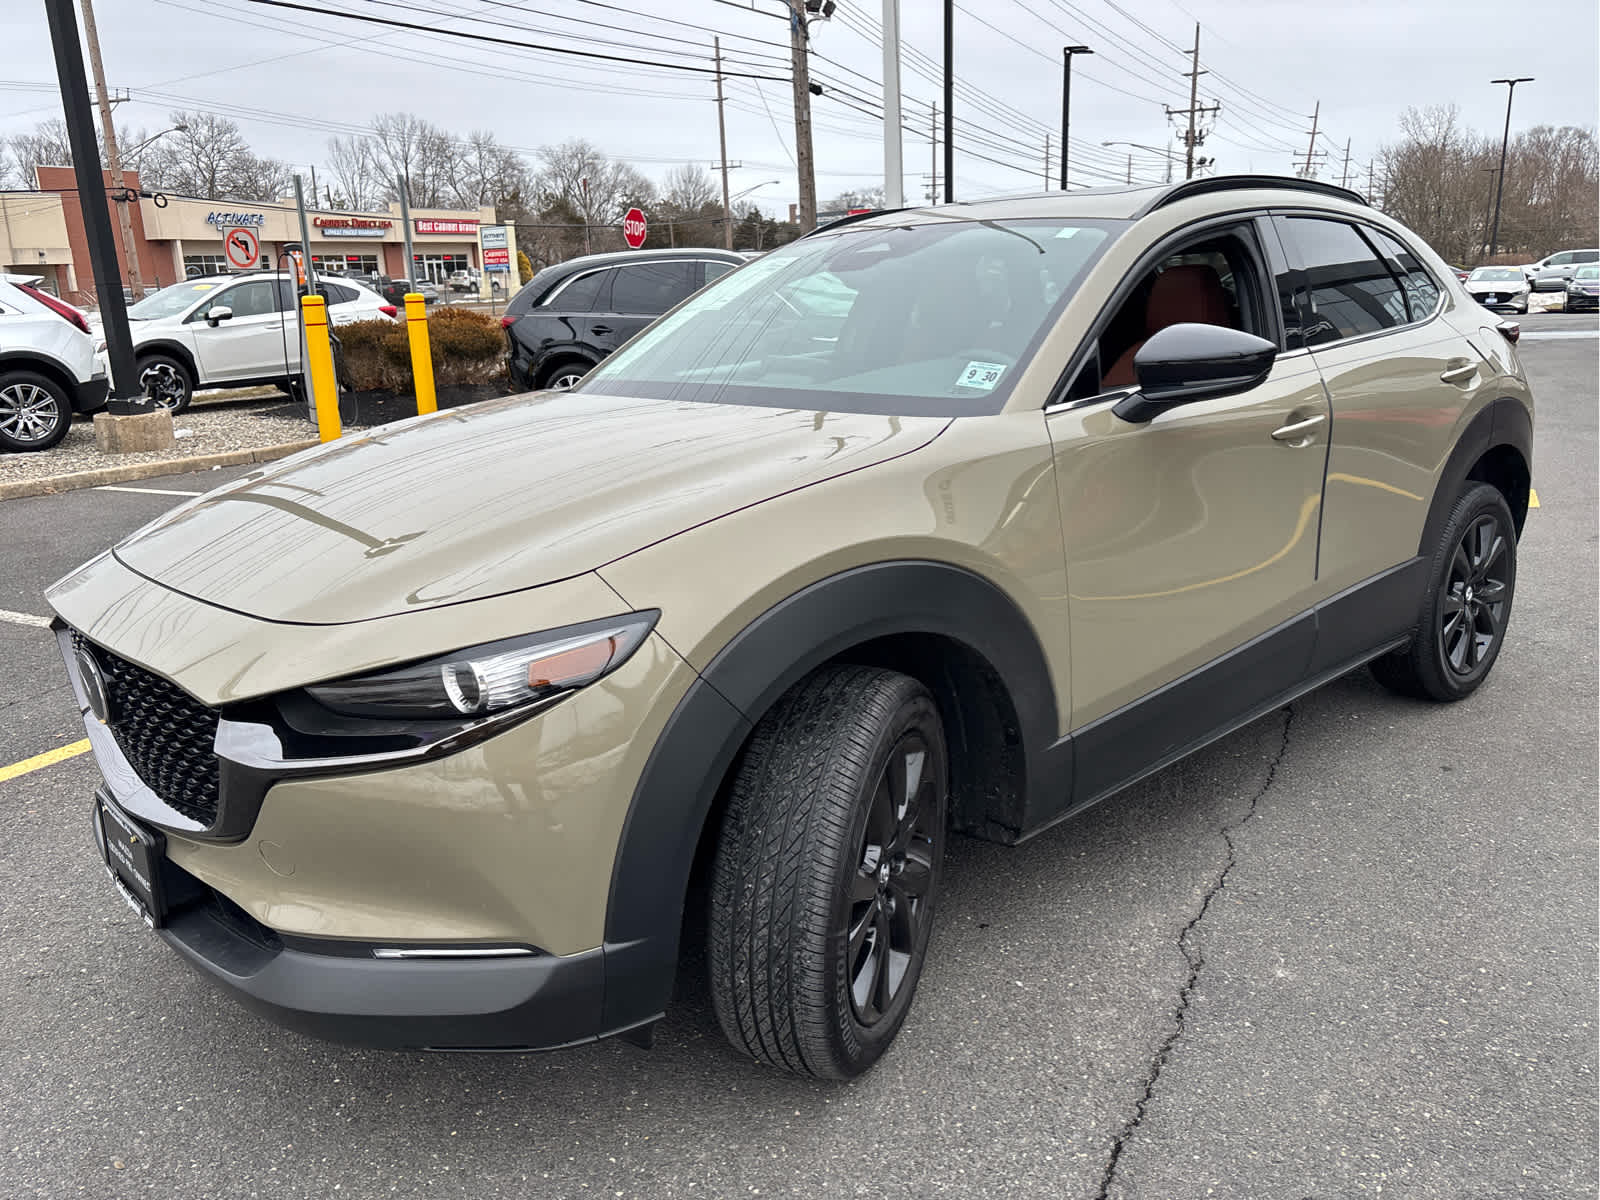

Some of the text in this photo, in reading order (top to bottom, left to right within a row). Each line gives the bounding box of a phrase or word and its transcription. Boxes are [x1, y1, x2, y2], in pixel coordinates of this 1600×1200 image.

[207, 211, 265, 225] ACTIVATE
[313, 217, 350, 228] CABINETS
[418, 220, 433, 231] Best
[625, 219, 646, 237] STOP
[967, 369, 998, 382] 9 30
